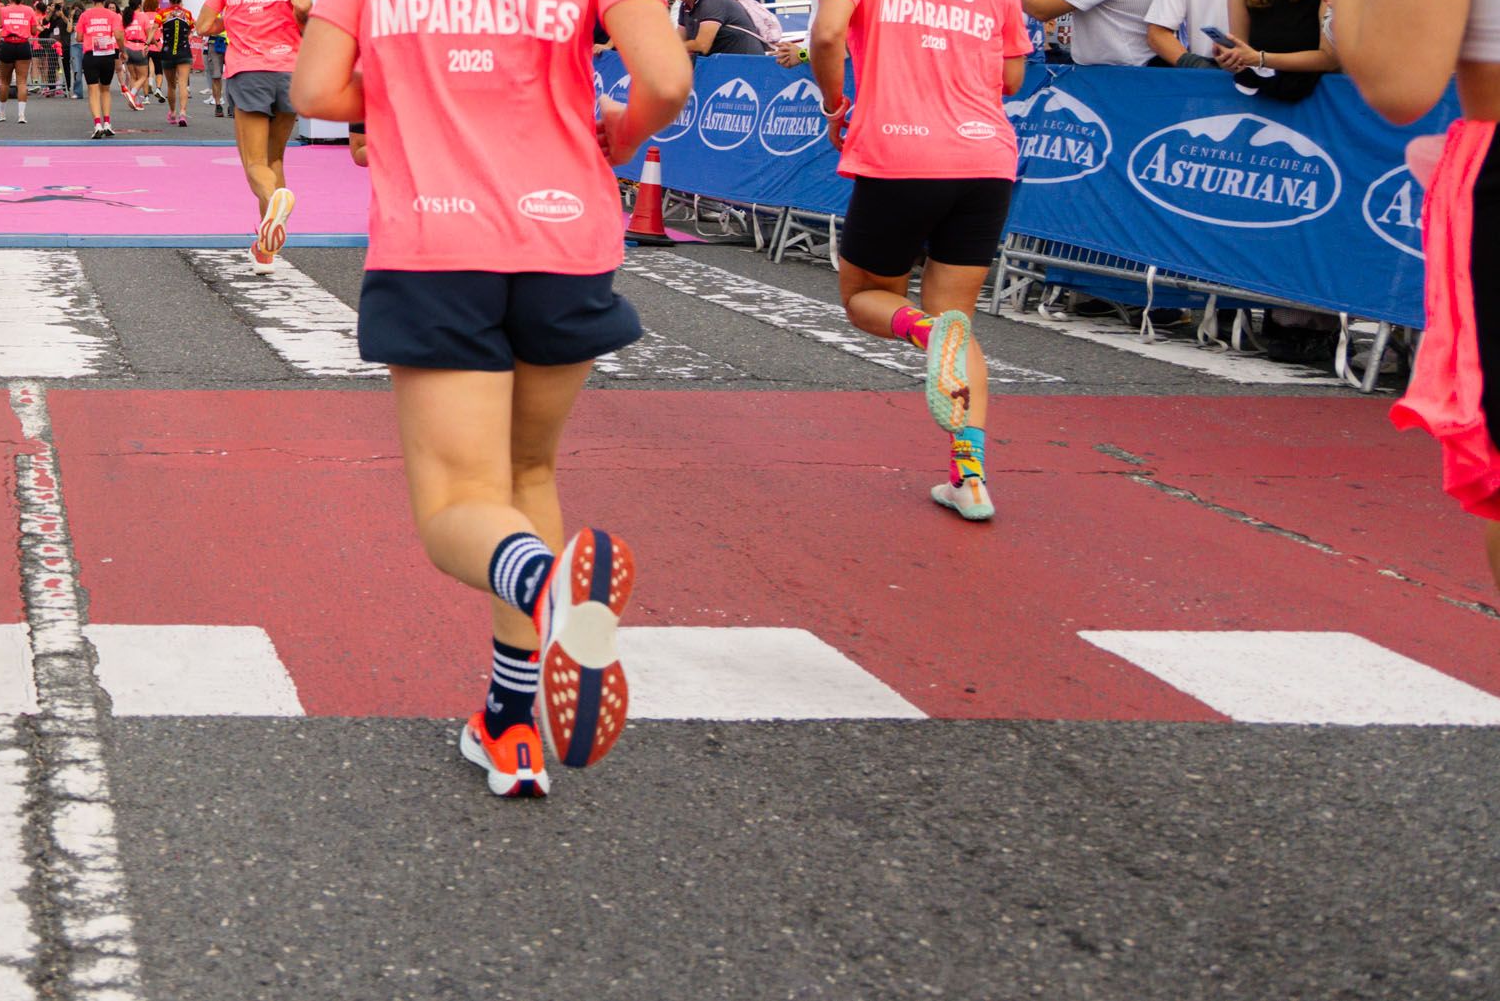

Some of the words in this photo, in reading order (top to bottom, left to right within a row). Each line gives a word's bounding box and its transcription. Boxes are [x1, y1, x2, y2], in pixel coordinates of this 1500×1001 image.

[921, 34, 947, 50] 2026
[448, 48, 494, 73] 2026
[701, 106, 752, 134] ASTURIANA
[762, 107, 821, 137] ASTURIANA
[882, 123, 930, 136] OYSHO
[1179, 143, 1244, 165] CENTRAL
[1248, 153, 1321, 176] LECHERA
[1138, 142, 1319, 211] ASTURIANA
